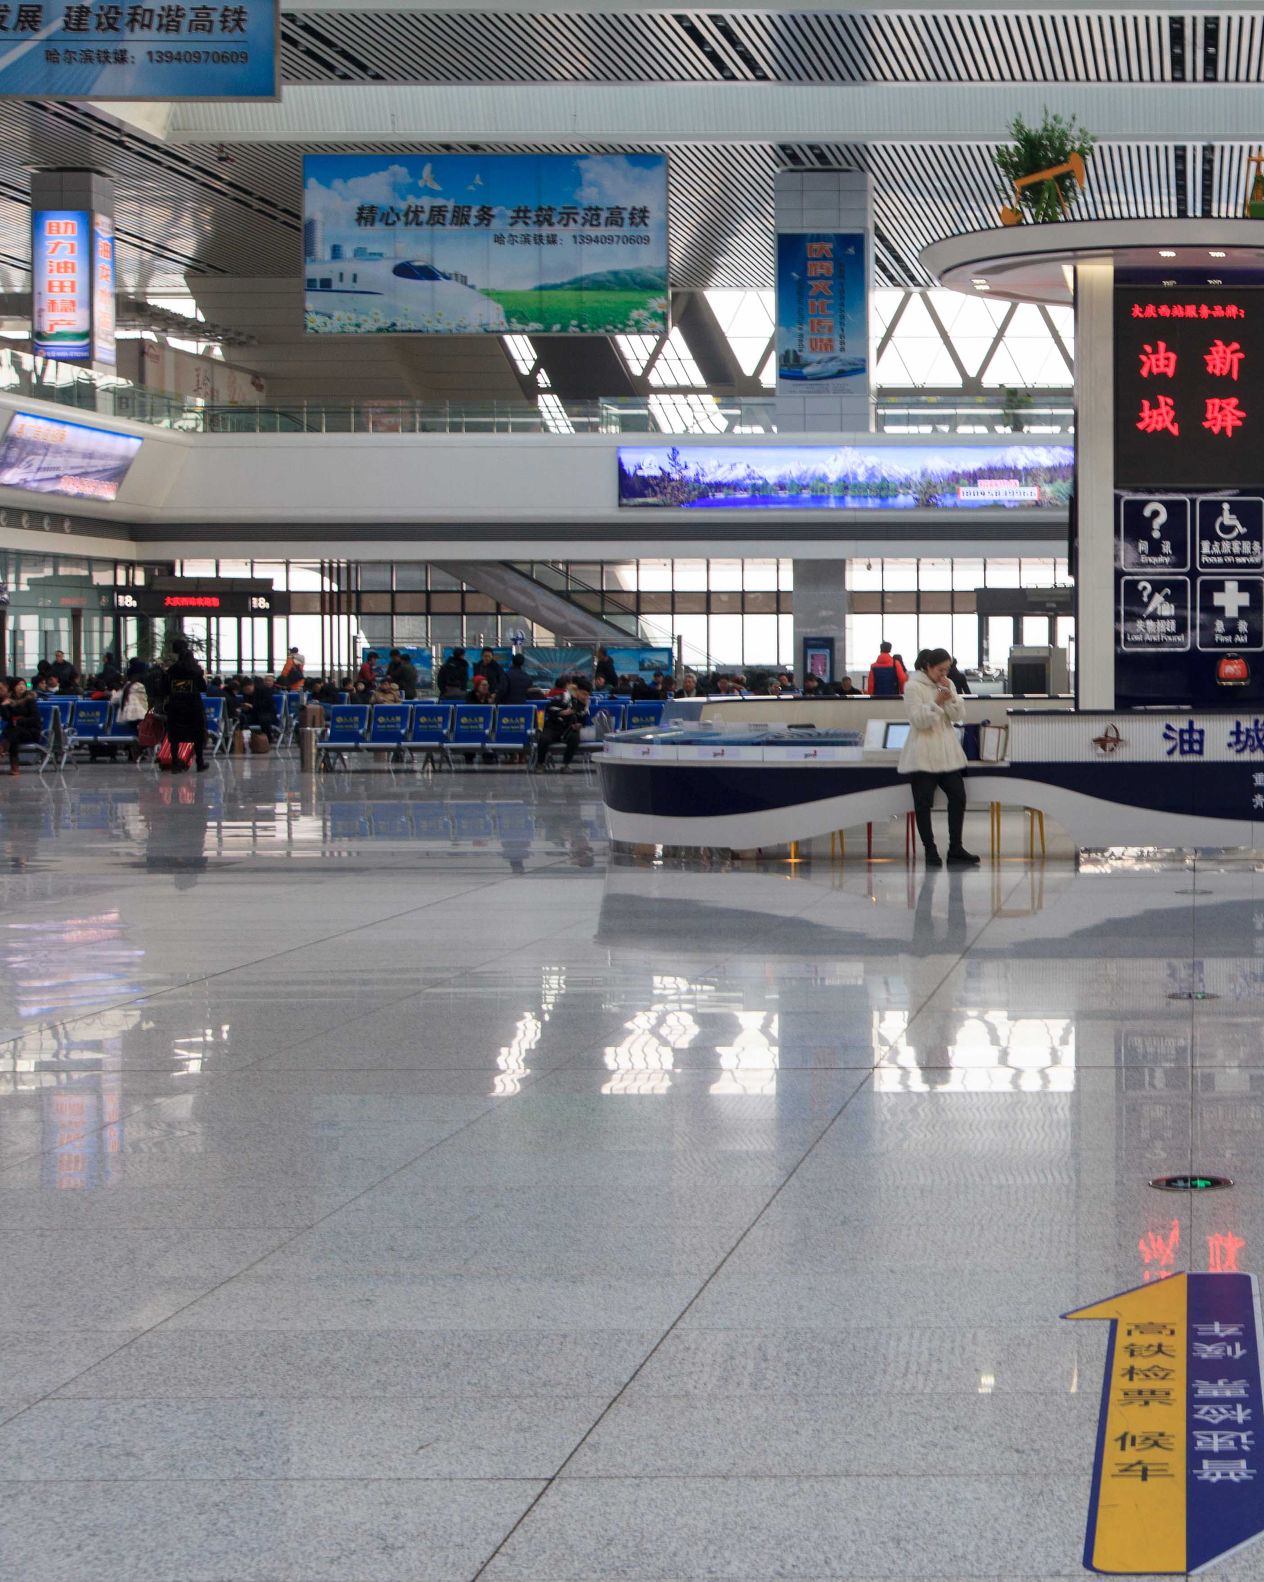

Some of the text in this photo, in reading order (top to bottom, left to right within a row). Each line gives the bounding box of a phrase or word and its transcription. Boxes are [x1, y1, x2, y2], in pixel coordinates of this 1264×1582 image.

[63, 4, 248, 34] 建设和谐高铁
[147, 50, 249, 65] 13940970609
[355, 204, 650, 228] 精心优质服务 共筑示范高铁
[572, 233, 650, 246] 13940970609
[46, 220, 77, 333] 助力油田稳产
[1140, 555, 1171, 564] Enquiry
[1127, 633, 1144, 642] Lost
[1215, 634, 1248, 643] First Aid
[1110, 1322, 1177, 1481] 高铁检票 候车
[1192, 1321, 1257, 1483] 普速检票 候车
